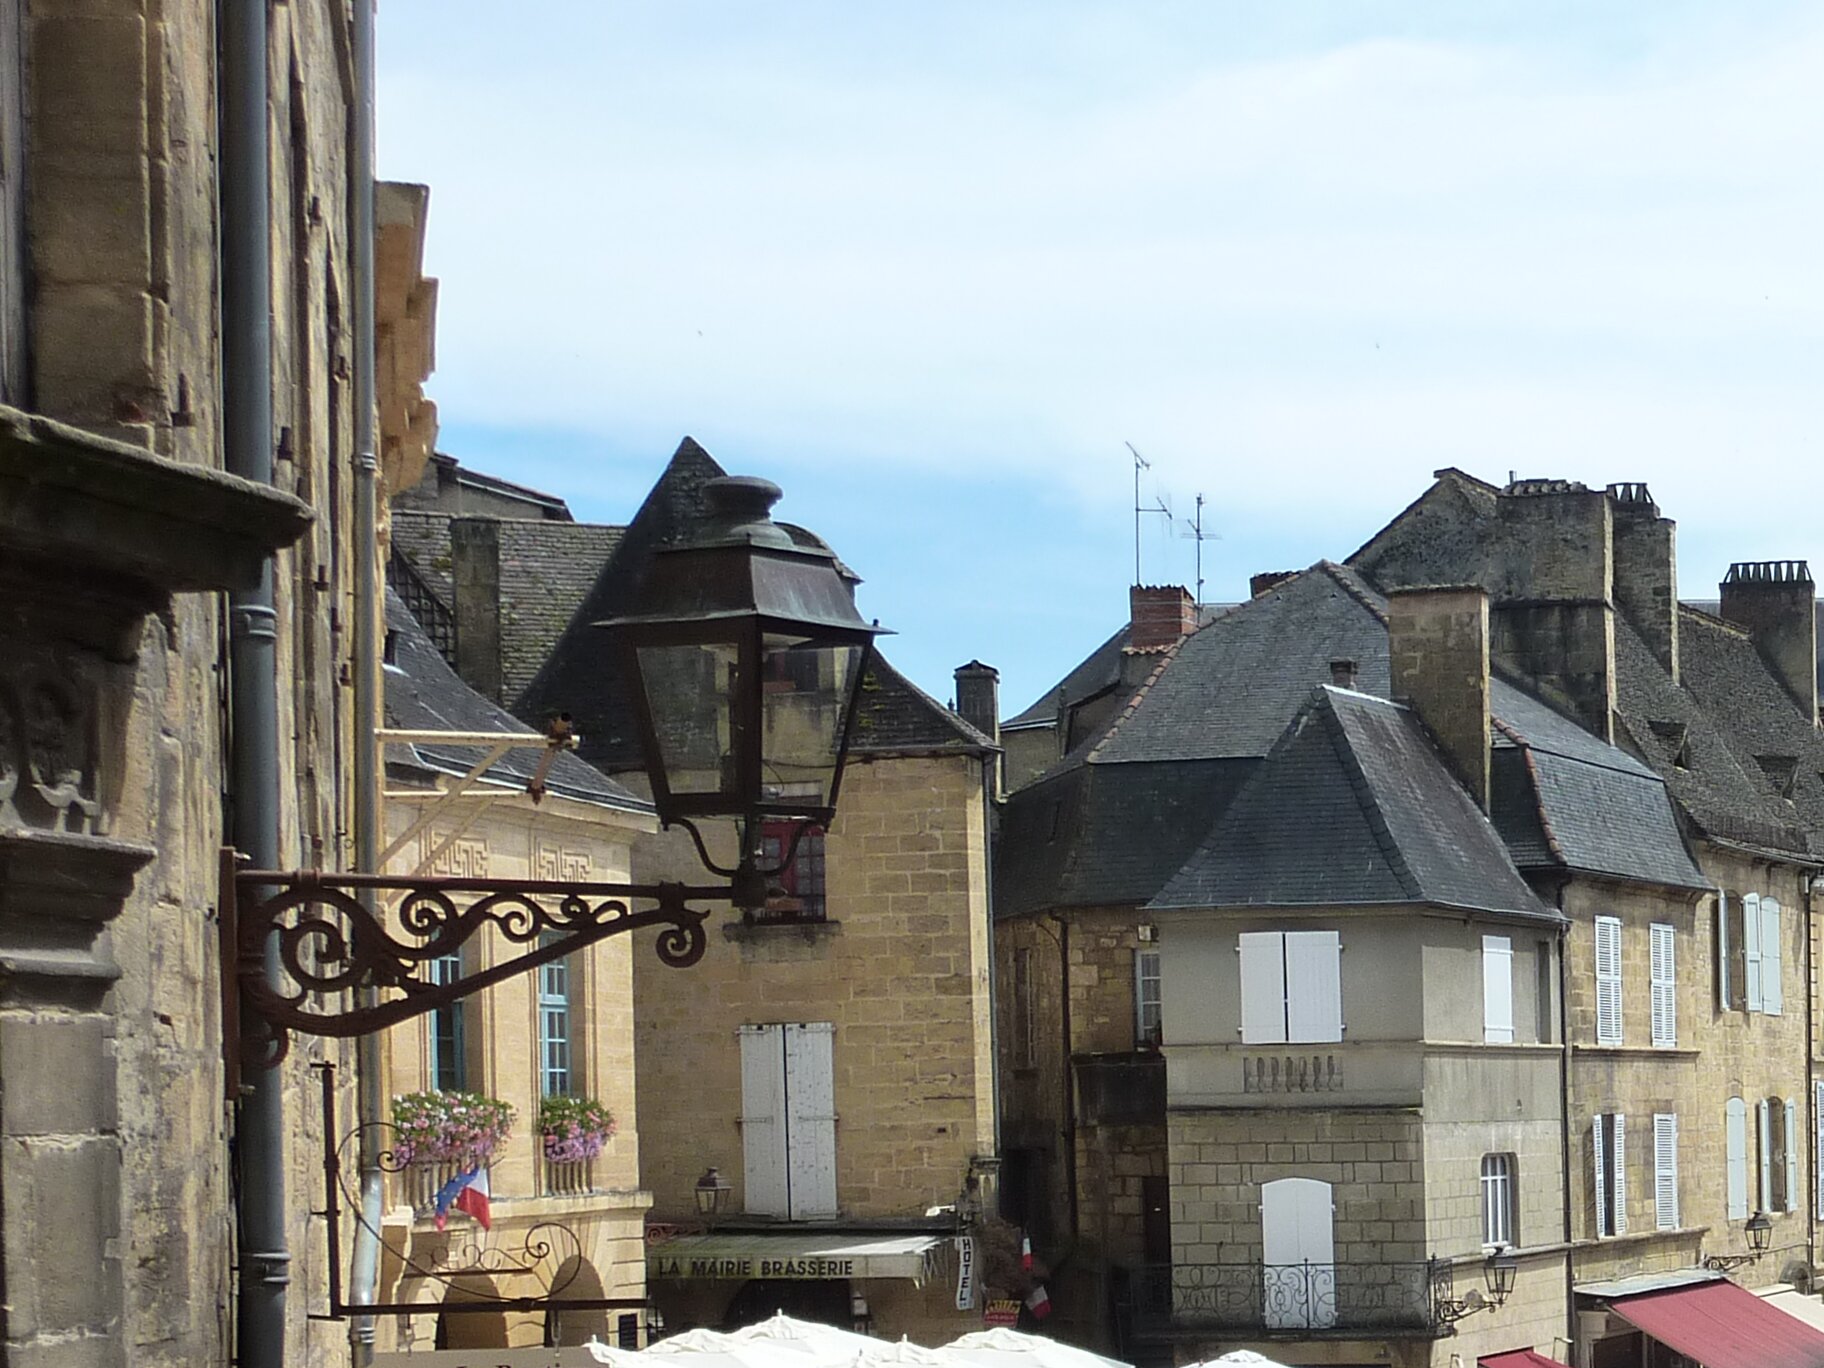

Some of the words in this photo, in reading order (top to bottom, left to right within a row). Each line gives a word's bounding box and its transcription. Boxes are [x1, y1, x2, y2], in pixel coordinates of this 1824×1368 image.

[658, 1260, 680, 1276] LA
[691, 1260, 750, 1276] MAIRIE
[760, 1260, 854, 1276] BRASSERIE
[960, 1239, 971, 1302] HOTEL
